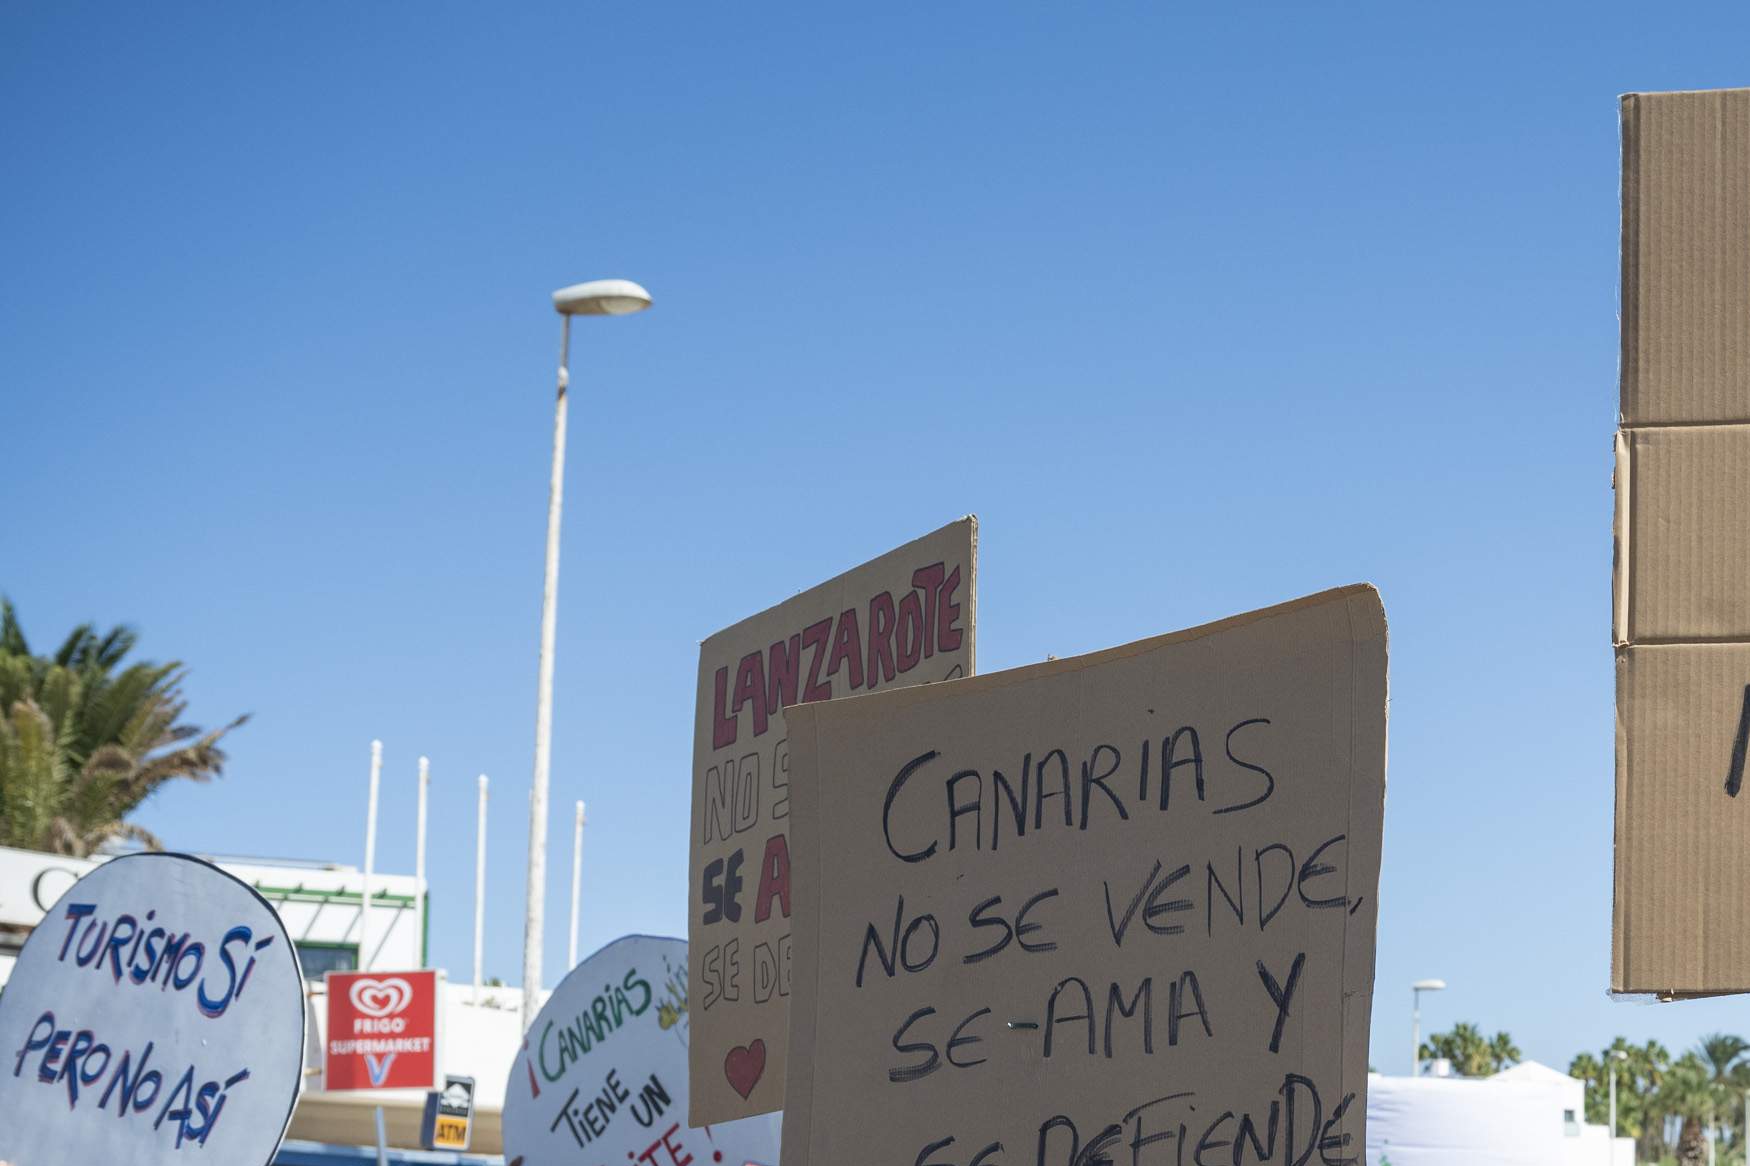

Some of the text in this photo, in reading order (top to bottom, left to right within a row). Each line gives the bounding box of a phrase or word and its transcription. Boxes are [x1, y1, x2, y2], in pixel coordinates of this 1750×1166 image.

[713, 562, 963, 750] LANZAROTE
[704, 752, 759, 845] NO
[703, 848, 744, 925] SE
[856, 835, 1363, 987] NO SE VENDE,
[703, 938, 739, 1010] SE
[1257, 953, 1305, 1053] Y
[14, 1011, 107, 1111] PERO
[98, 1041, 163, 1118] NO
[330, 1037, 430, 1056] SUPERMARKET
[353, 1018, 405, 1034] FRIGO
[436, 1122, 466, 1144] ATM
[631, 1074, 672, 1127] UN
